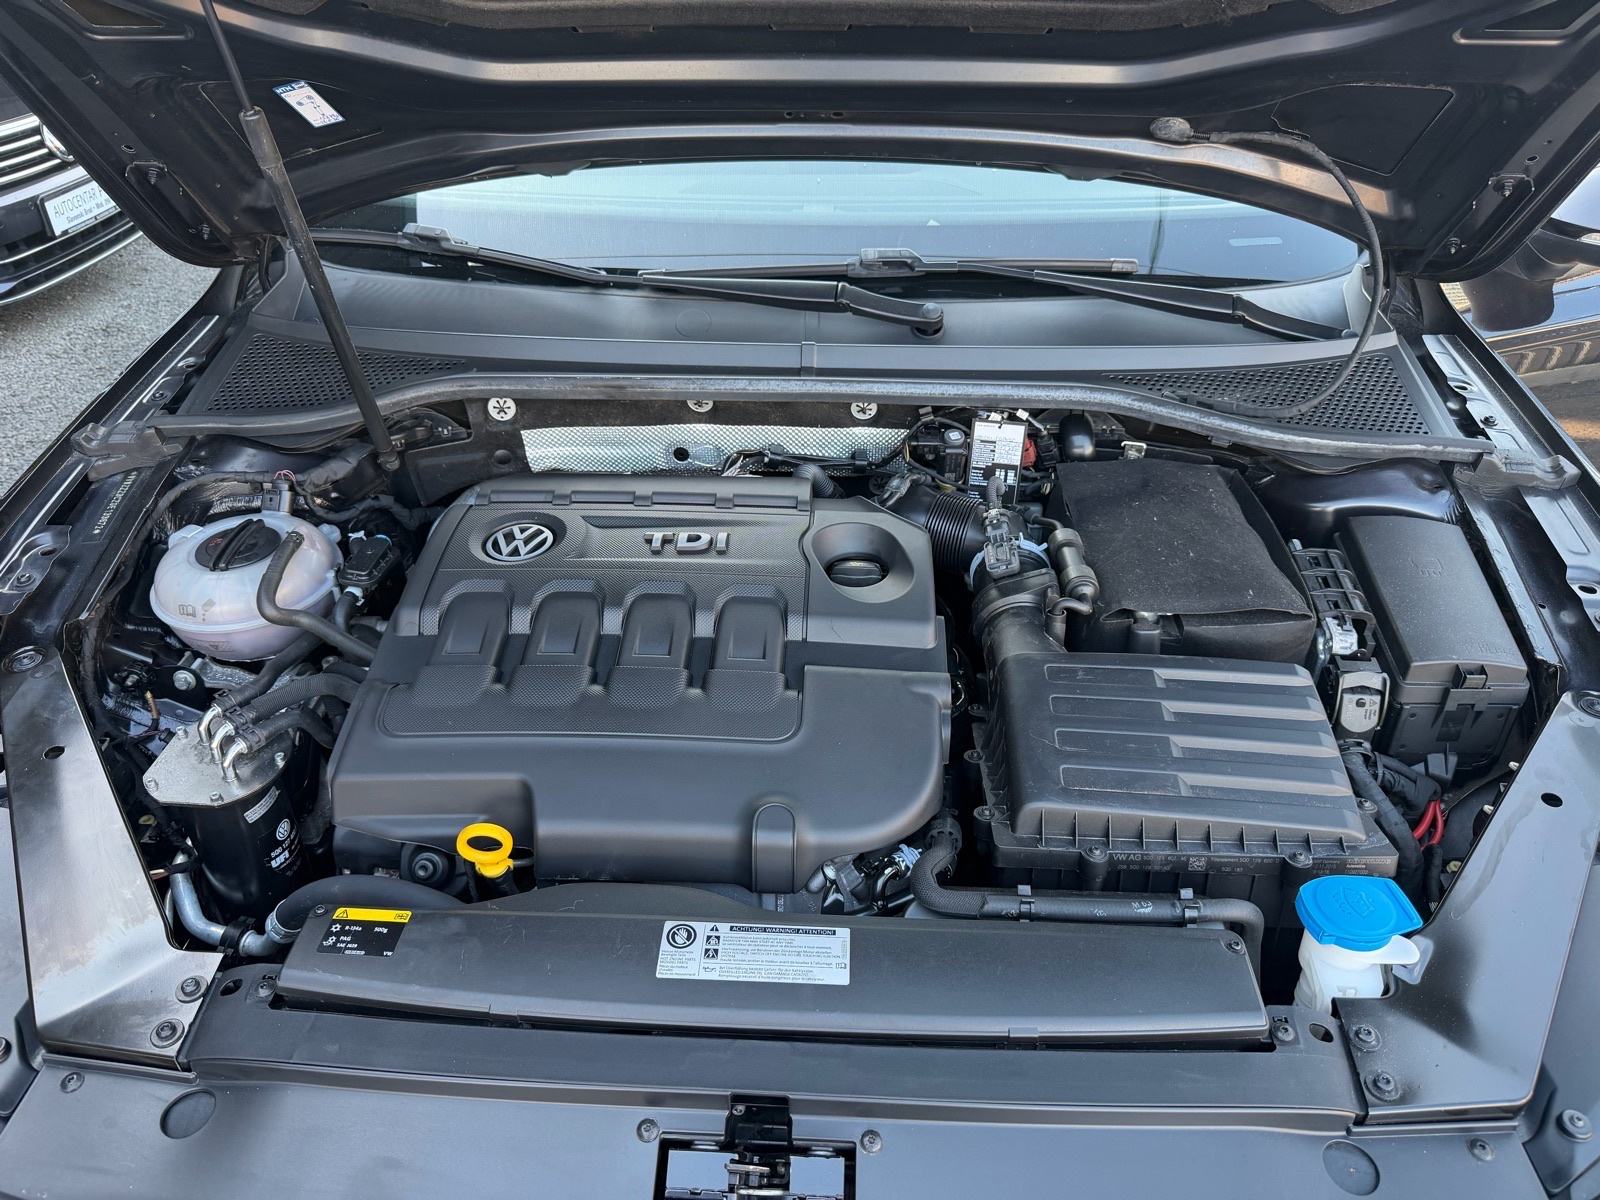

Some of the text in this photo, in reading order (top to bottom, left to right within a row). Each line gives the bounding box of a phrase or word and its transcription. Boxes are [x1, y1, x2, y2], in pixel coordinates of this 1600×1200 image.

[53, 187, 98, 218] AUTOCENTAR
[644, 532, 730, 554] TDI
[731, 925, 765, 933] ACHTUNG!
